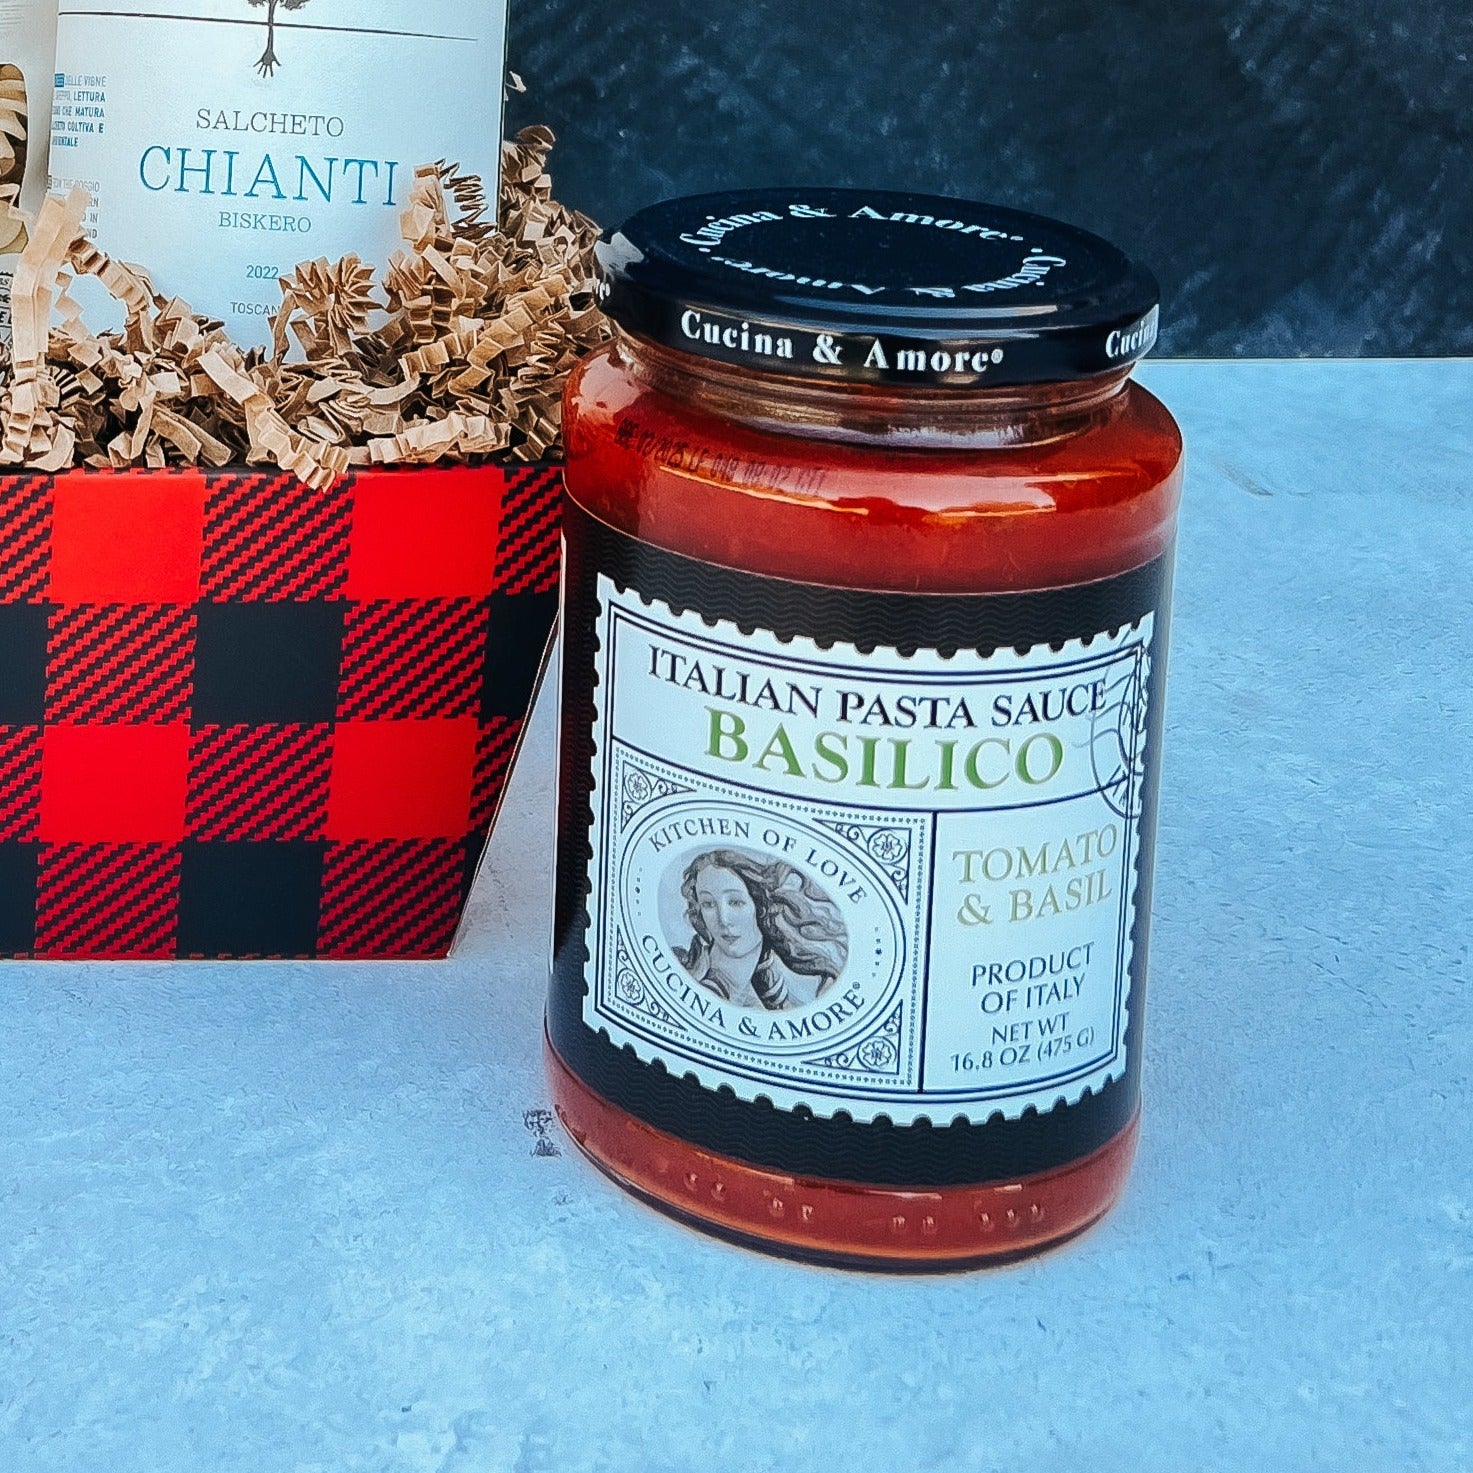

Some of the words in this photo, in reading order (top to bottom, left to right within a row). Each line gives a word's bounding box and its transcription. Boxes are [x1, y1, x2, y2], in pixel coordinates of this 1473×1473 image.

[74, 91, 106, 103] LETTURA
[98, 122, 104, 134] E
[196, 108, 344, 137] SALCHETO
[139, 144, 399, 207] CHIANTI
[218, 210, 312, 234] BISKERO
[680, 211, 783, 246] Cucina
[788, 204, 837, 218] &
[848, 205, 1008, 240] Amore
[246, 264, 279, 280] 2022
[230, 302, 280, 316] TOSCAN
[681, 309, 794, 359] Cucina
[812, 334, 843, 365] &
[864, 337, 989, 373] Amore
[648, 644, 822, 717] ITALIAN
[836, 690, 977, 730] PASTA
[990, 678, 1106, 727] SAUCE
[704, 705, 1065, 792] BASILICO
[648, 817, 751, 853] KITCHEN
[763, 829, 798, 853] OF
[805, 849, 867, 904] LOVE
[952, 823, 1118, 884] TOMATO
[957, 893, 993, 927] &
[1008, 868, 1112, 923] BASIL
[971, 941, 1095, 987] PRODUCT
[642, 934, 726, 1028] CUCINA
[737, 1017, 761, 1038] &
[767, 989, 865, 1041] AMORE
[981, 989, 1018, 1014] OF
[1026, 973, 1085, 1009] ITALY
[950, 1050, 993, 1073] 16.8
[1000, 1044, 1032, 1066] OZ
[1037, 1037, 1072, 1062] (475
[1077, 1026, 1095, 1047] G)
[992, 1019, 1033, 1045] NET
[1038, 1011, 1071, 1037] WT
